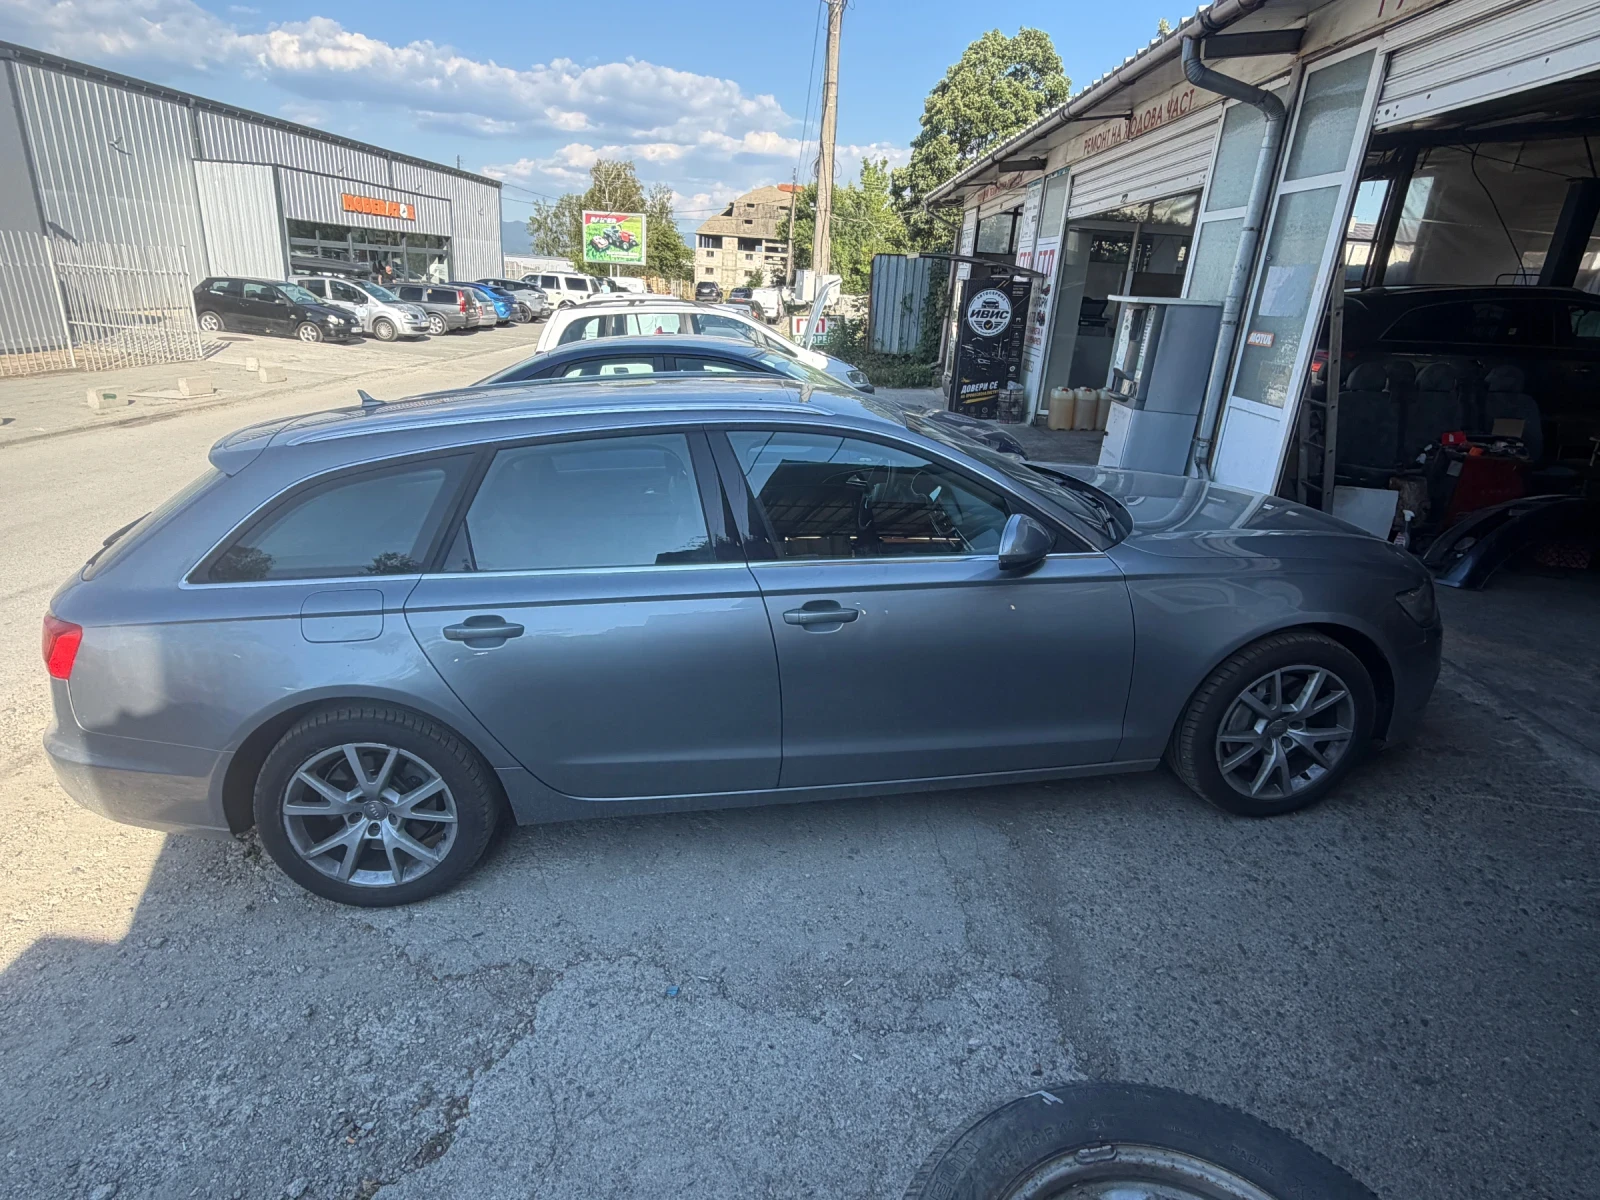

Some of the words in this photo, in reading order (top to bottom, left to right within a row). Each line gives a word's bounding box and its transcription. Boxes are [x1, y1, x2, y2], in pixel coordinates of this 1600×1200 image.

[1083, 129, 1111, 156] РЕМОНТ
[1111, 124, 1122, 144] НА
[1166, 88, 1195, 120] ЧАСТ
[970, 309, 1010, 320] ИВИС
[796, 318, 826, 333] ГП
[1249, 331, 1273, 346] MOTUL
[960, 382, 989, 394] ДОВЕРИ
[989, 380, 999, 390] СЕ
[1230, 1144, 1276, 1177] RADIAL
